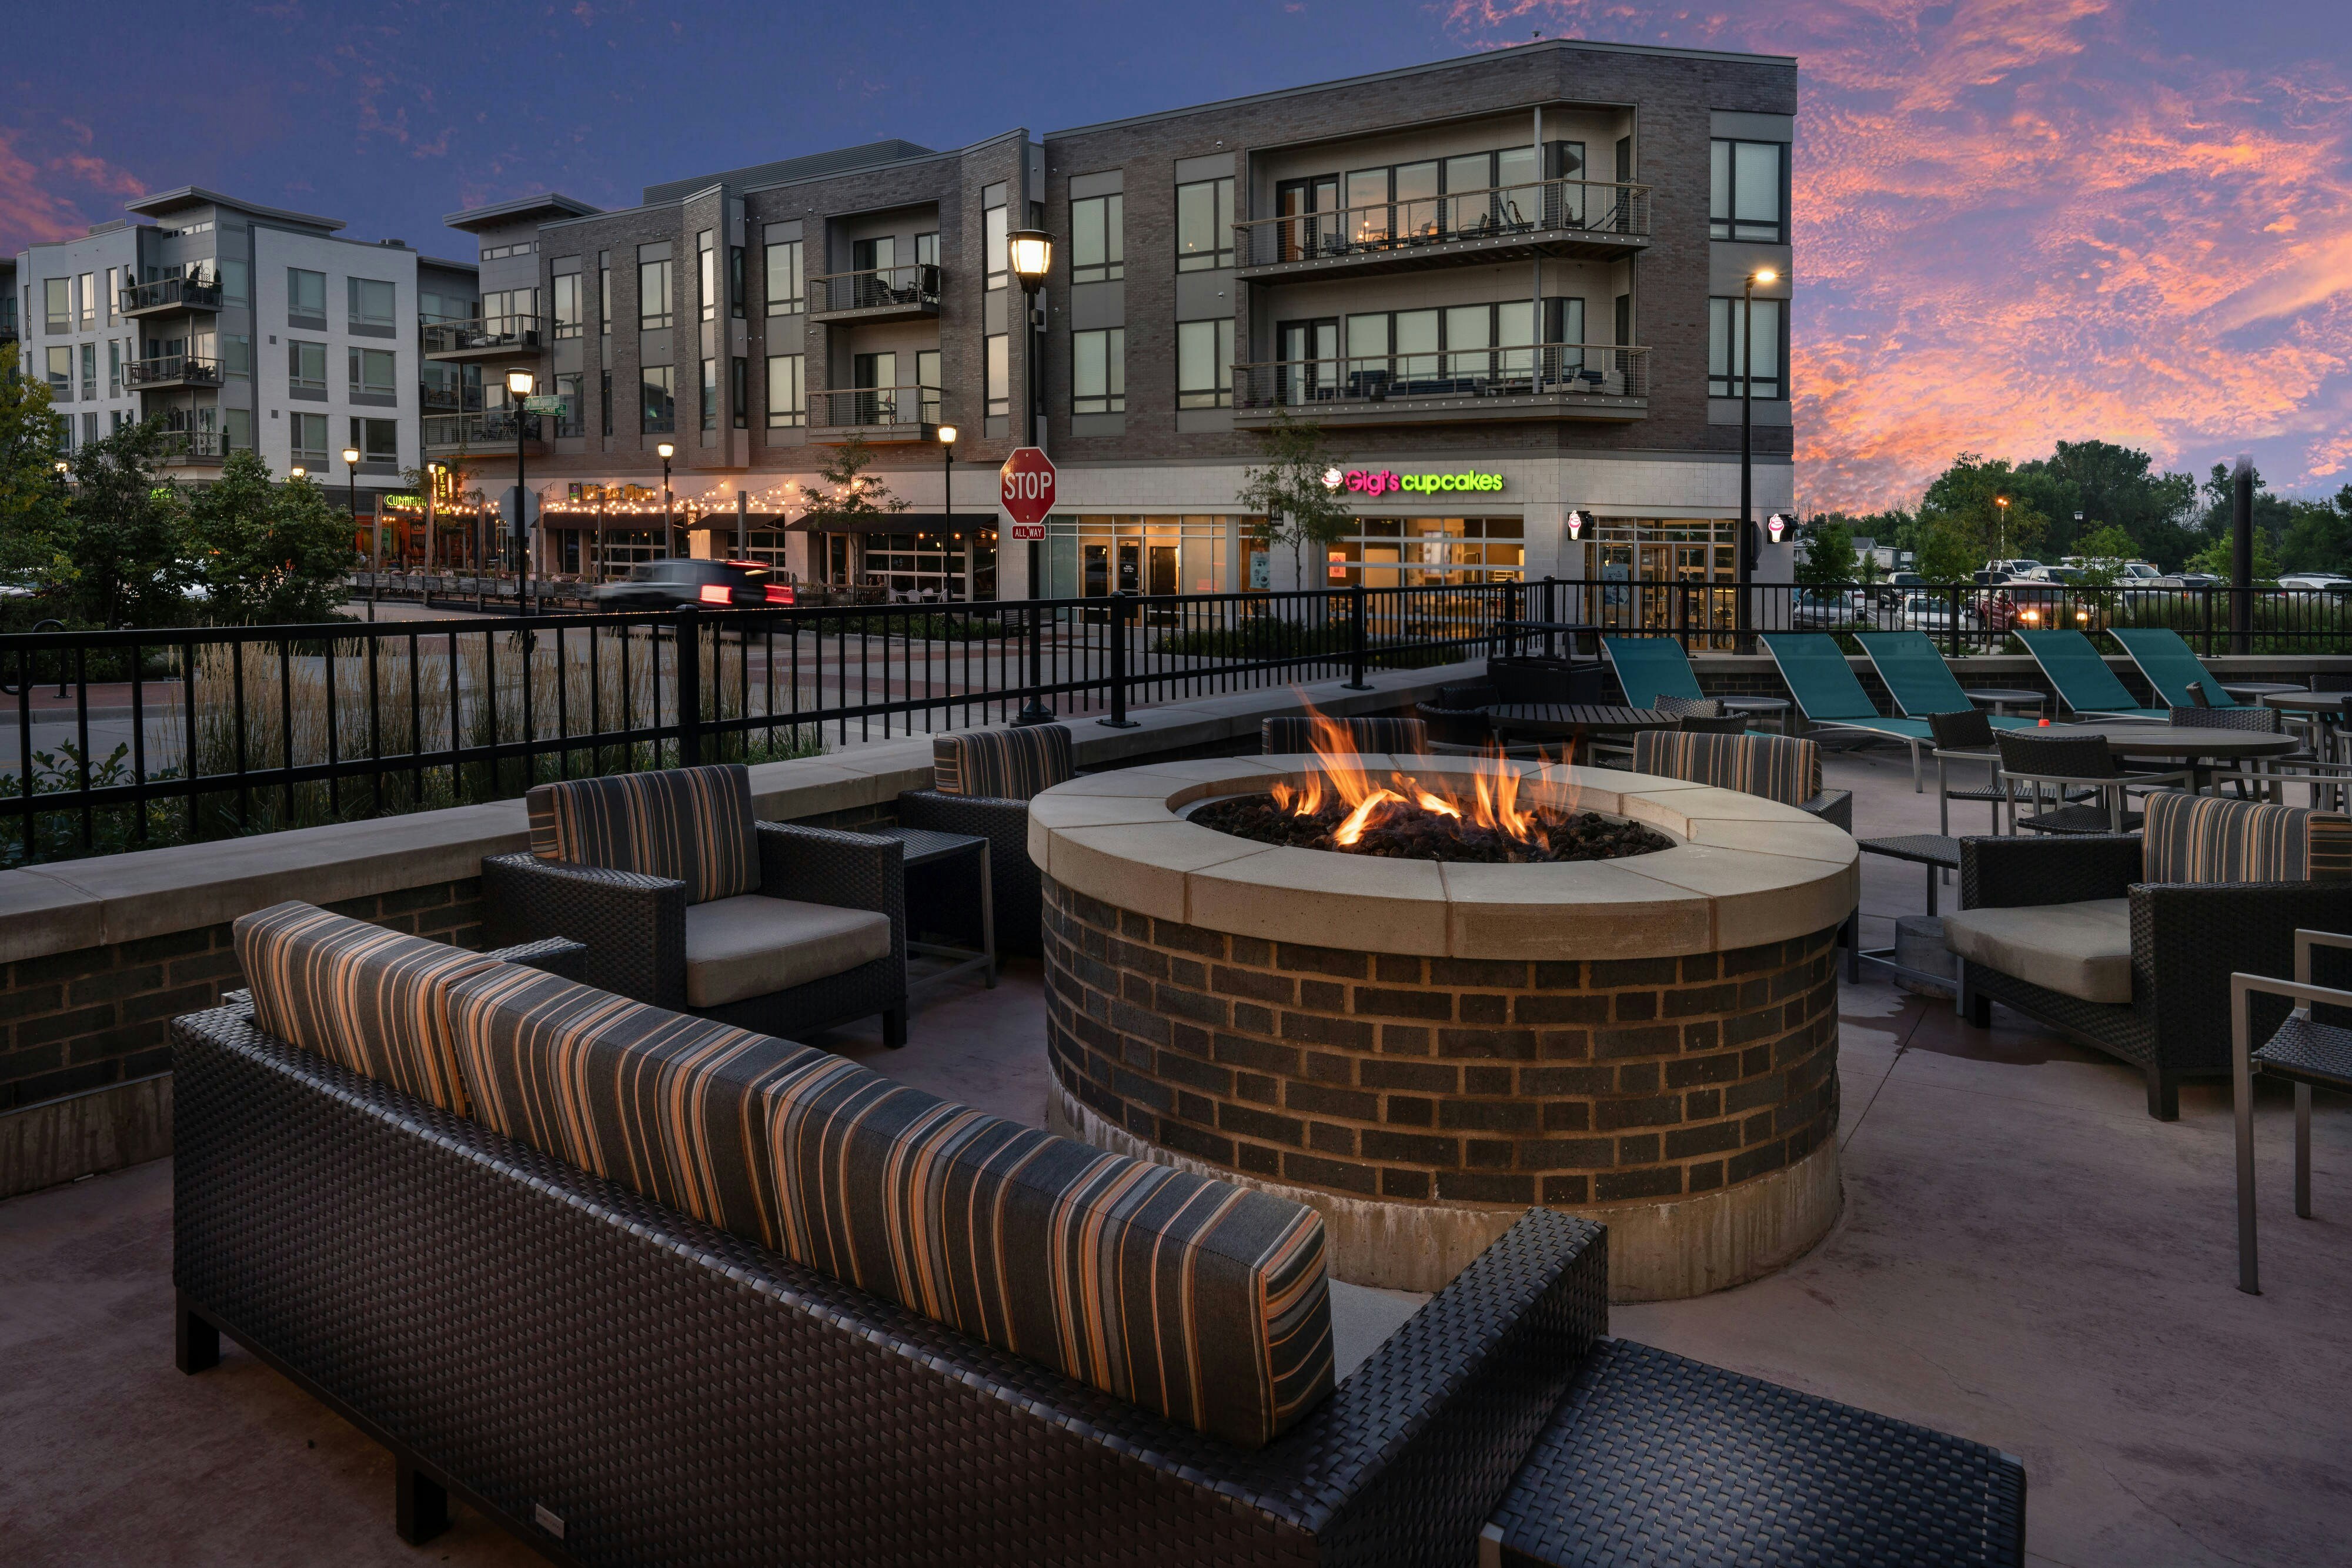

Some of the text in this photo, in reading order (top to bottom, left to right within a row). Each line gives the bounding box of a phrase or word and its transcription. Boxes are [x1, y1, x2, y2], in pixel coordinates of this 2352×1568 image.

[1004, 472, 1052, 499] STOP
[1346, 470, 1503, 496] Gigi's cupcakes
[1015, 529, 1042, 537] ALL WAY
